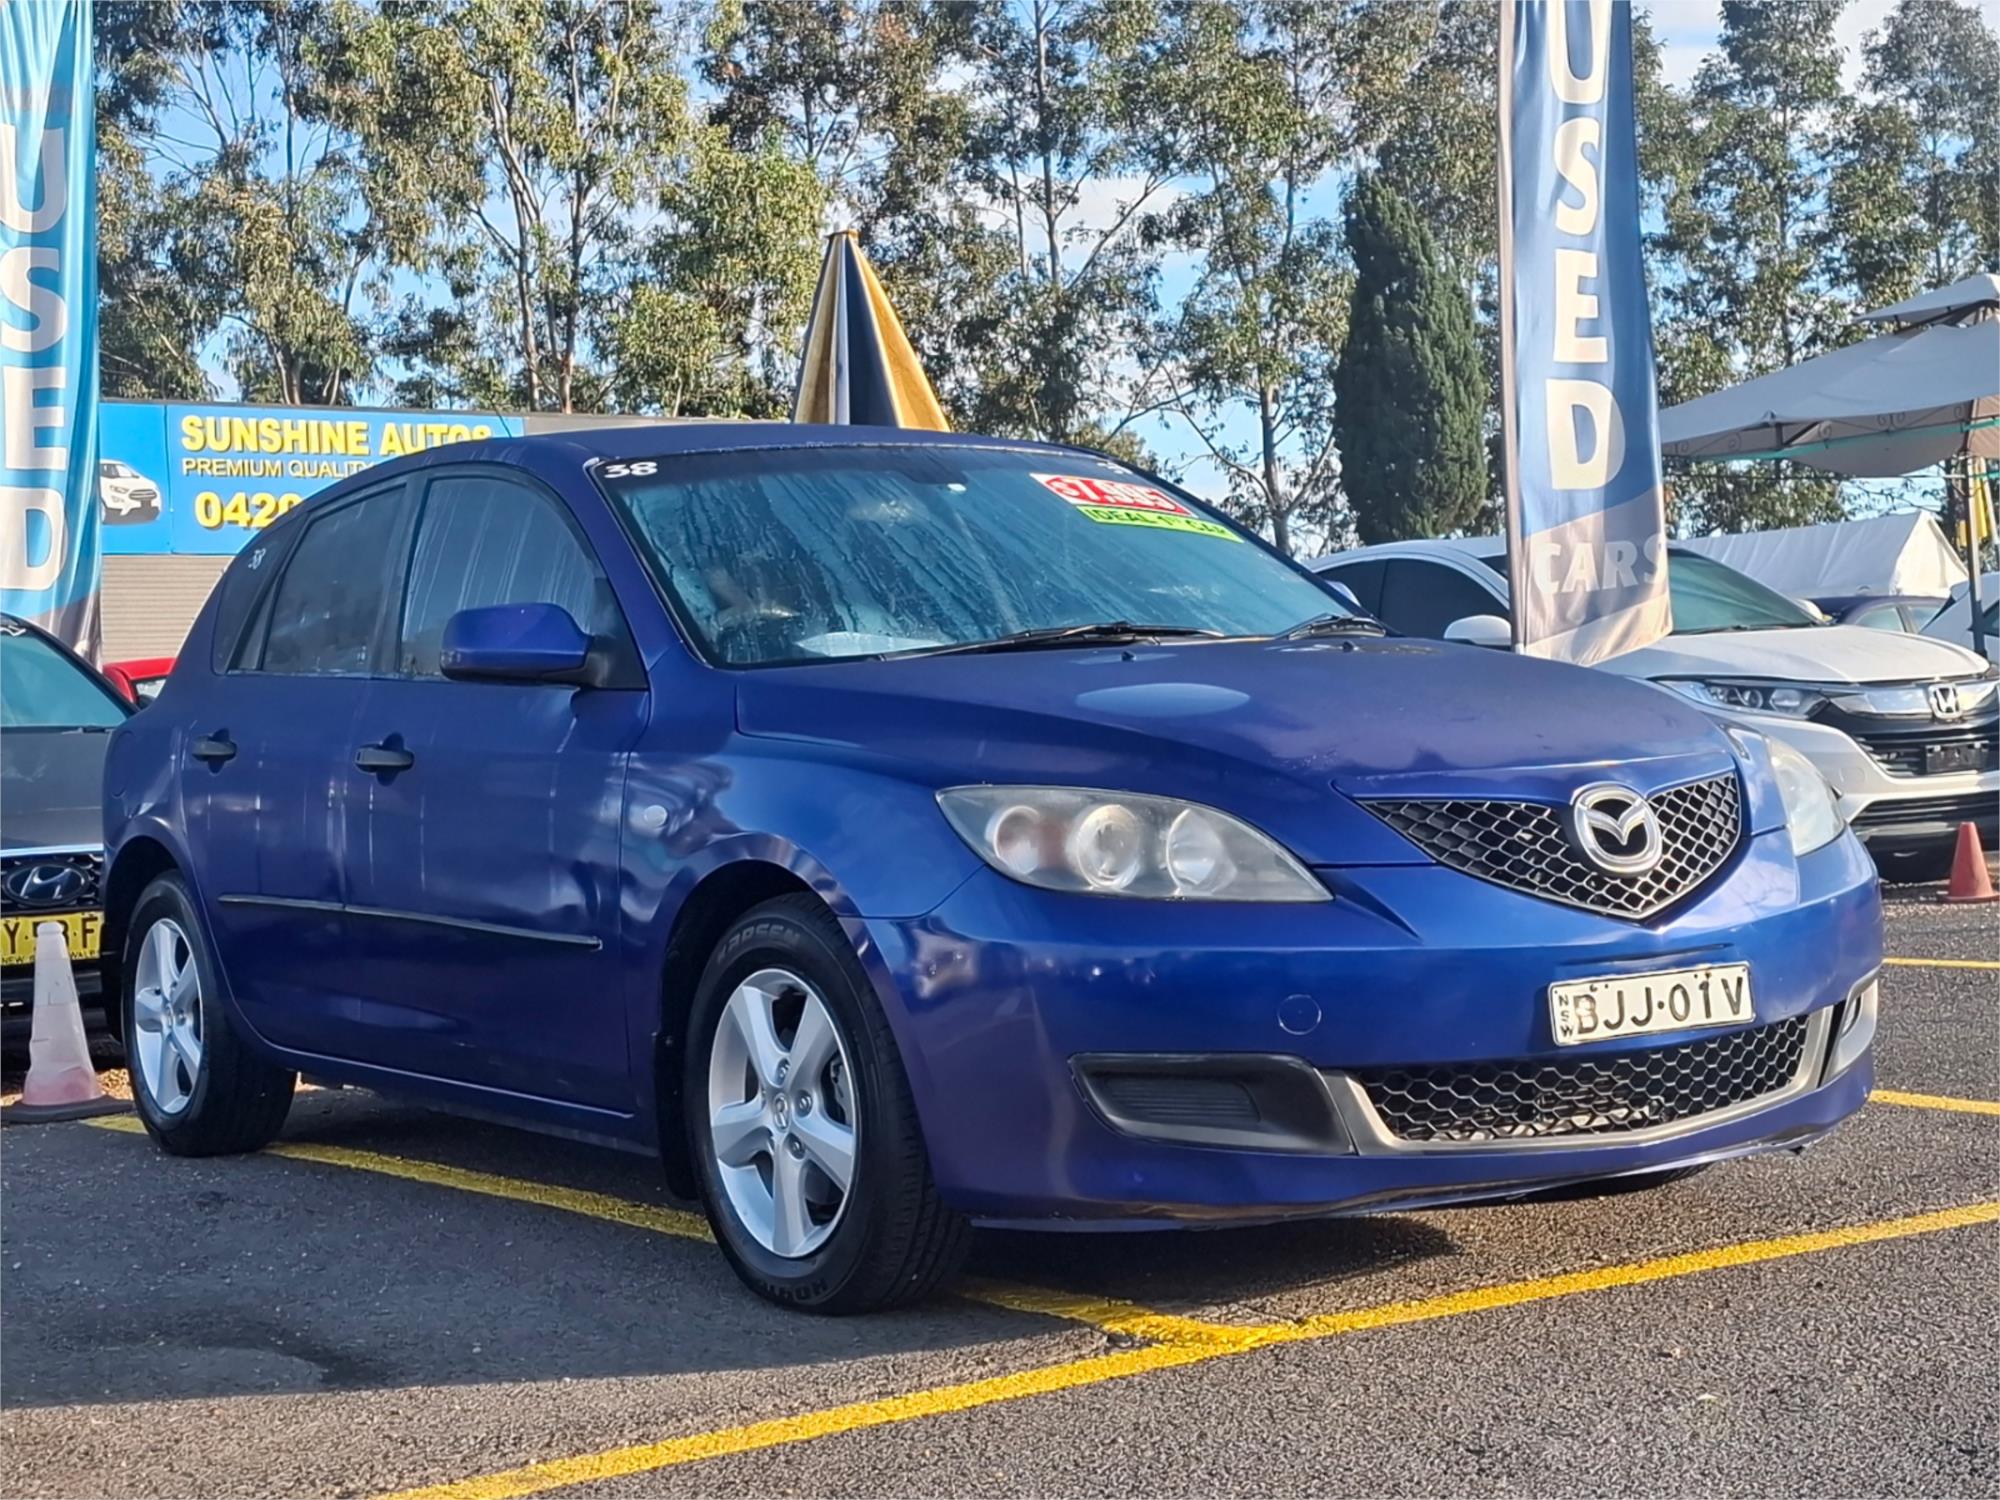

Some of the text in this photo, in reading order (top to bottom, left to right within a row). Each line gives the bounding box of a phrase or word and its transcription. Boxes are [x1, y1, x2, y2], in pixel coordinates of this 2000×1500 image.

[1546, 0, 1626, 490] USED
[0, 124, 68, 591] USED
[181, 415, 370, 455] SUNSHINE
[182, 457, 284, 477] PREMIUM
[604, 461, 658, 479] 38
[1533, 533, 1668, 594] CARS
